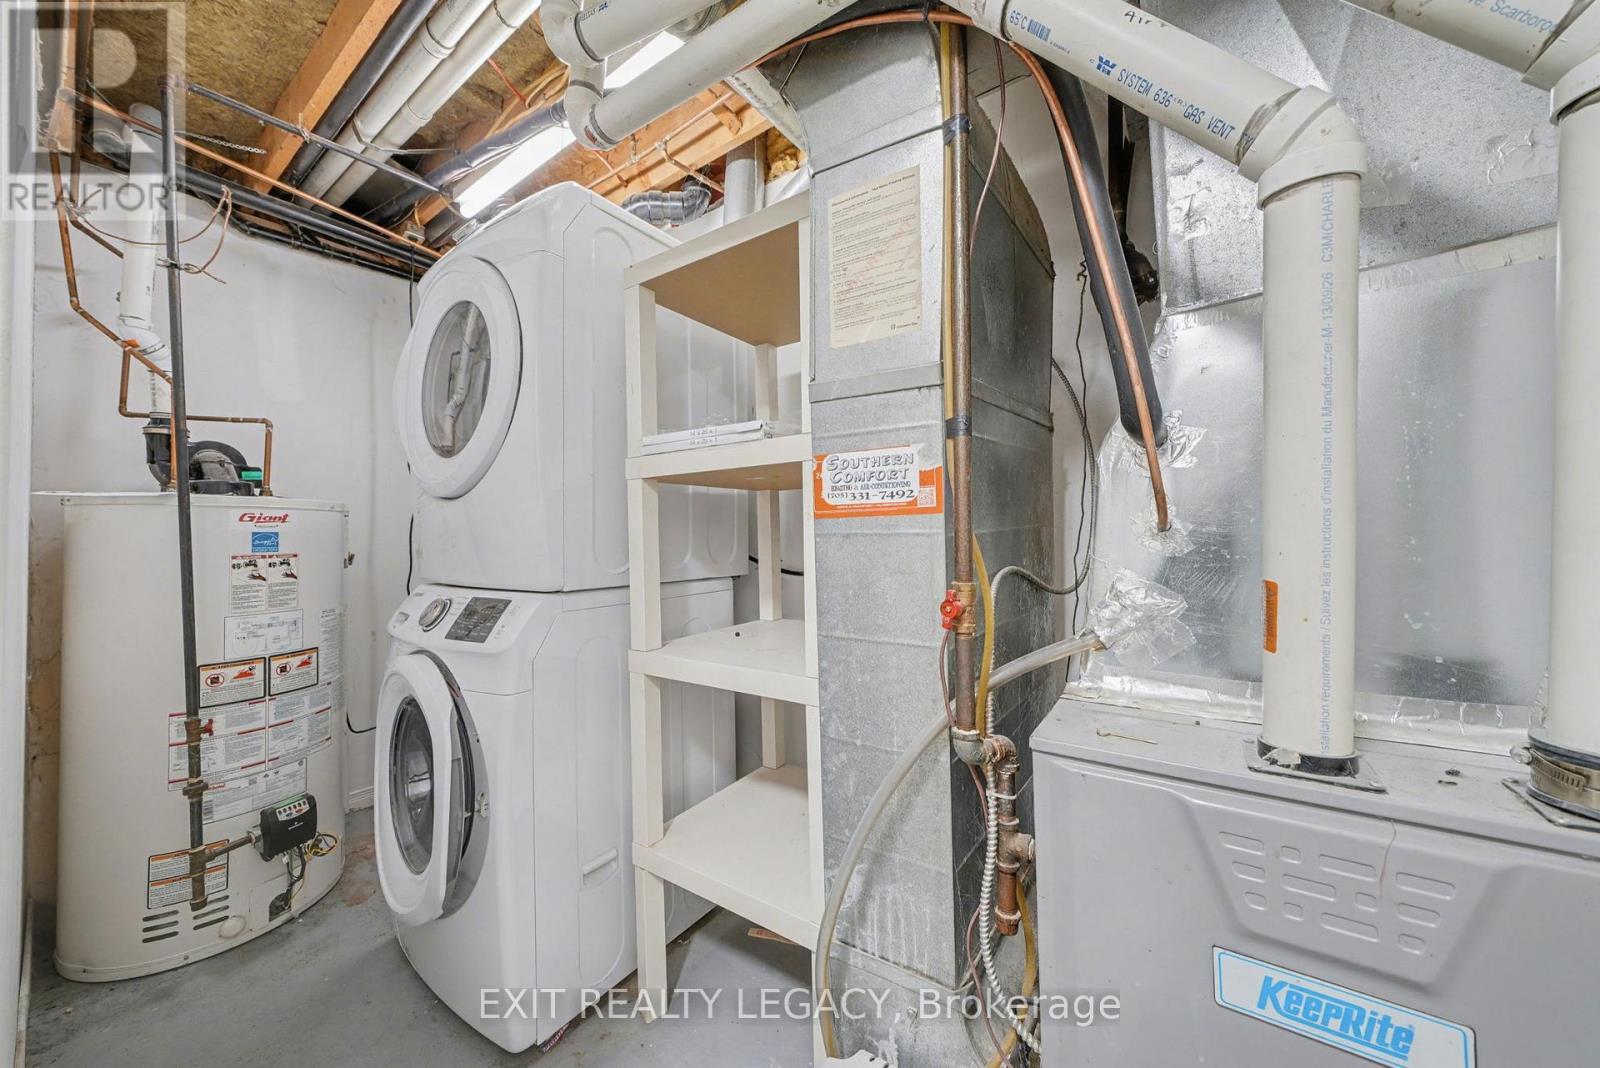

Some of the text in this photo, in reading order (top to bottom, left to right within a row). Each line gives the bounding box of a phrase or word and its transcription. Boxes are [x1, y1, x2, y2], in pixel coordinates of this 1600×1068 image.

[1117, 68, 1154, 96] SYSTEM
[1183, 103, 1205, 124] GAS
[1206, 115, 1236, 140] VENT
[827, 453, 914, 471] SOUTHERN
[831, 469, 909, 484] COMFORT
[849, 489, 915, 500] 331-7492
[239, 512, 289, 523] Giant
